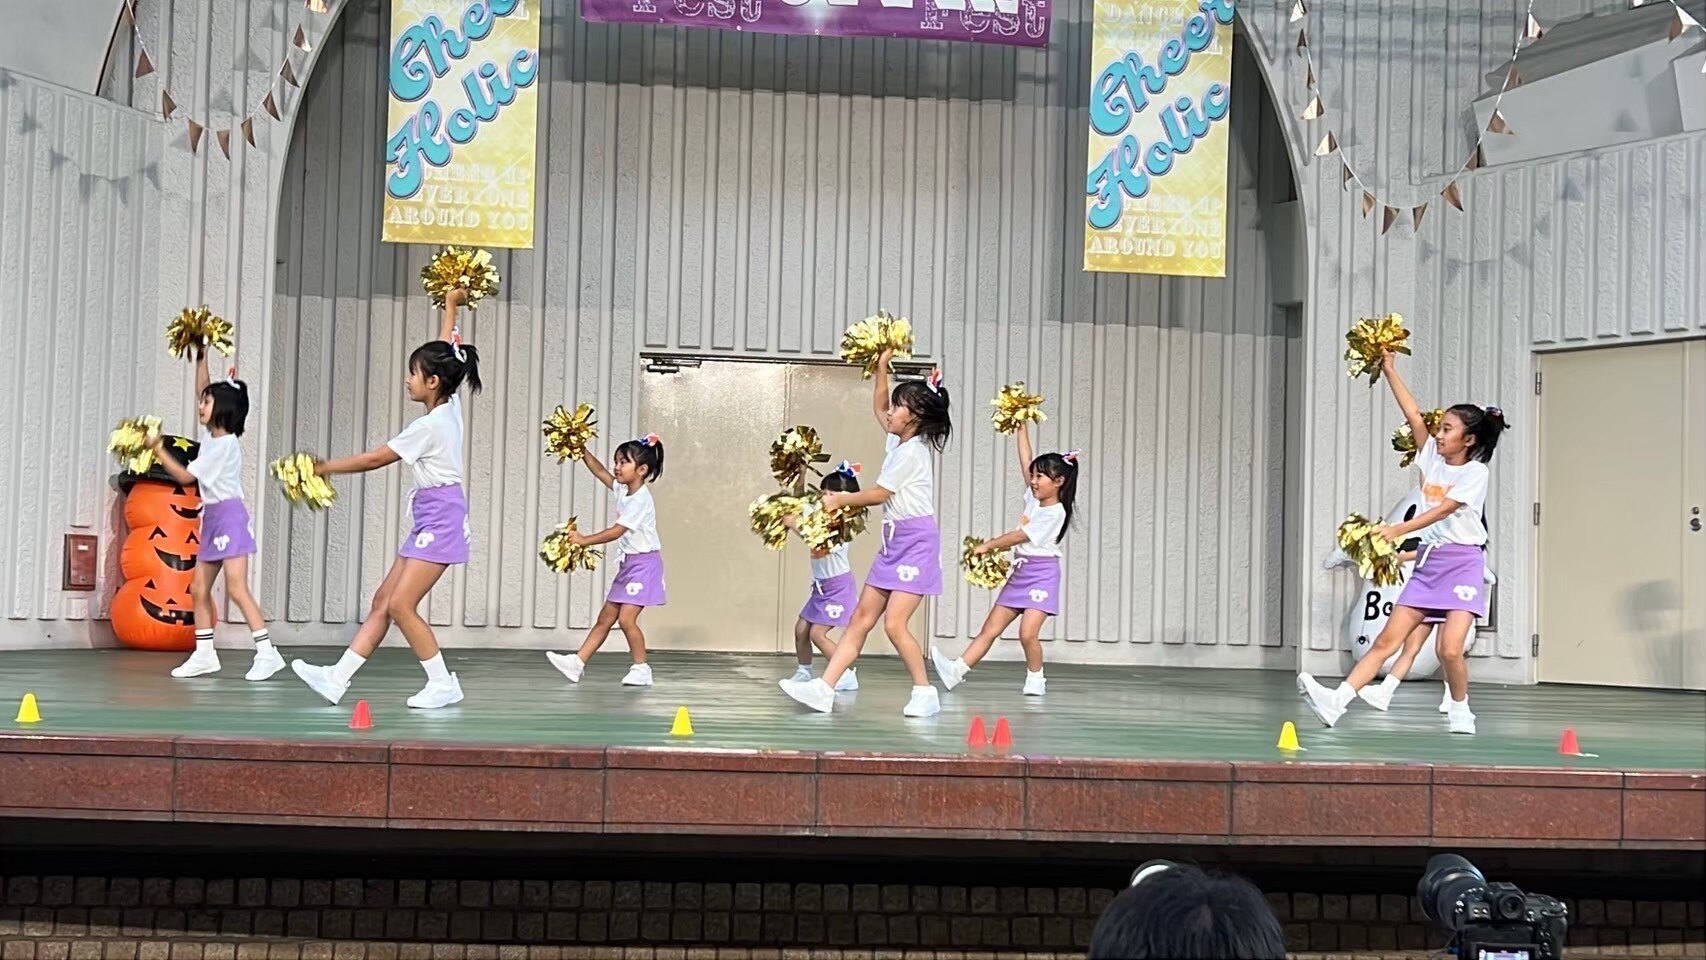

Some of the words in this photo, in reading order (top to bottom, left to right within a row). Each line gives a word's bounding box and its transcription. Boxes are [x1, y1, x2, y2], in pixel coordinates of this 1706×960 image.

[386, 48, 539, 199] Holic
[1087, 83, 1230, 230] Holic
[387, 206, 481, 229] AROUND
[486, 210, 529, 232] YOU
[1089, 235, 1176, 258] AROUND
[1182, 239, 1222, 260] YOU
